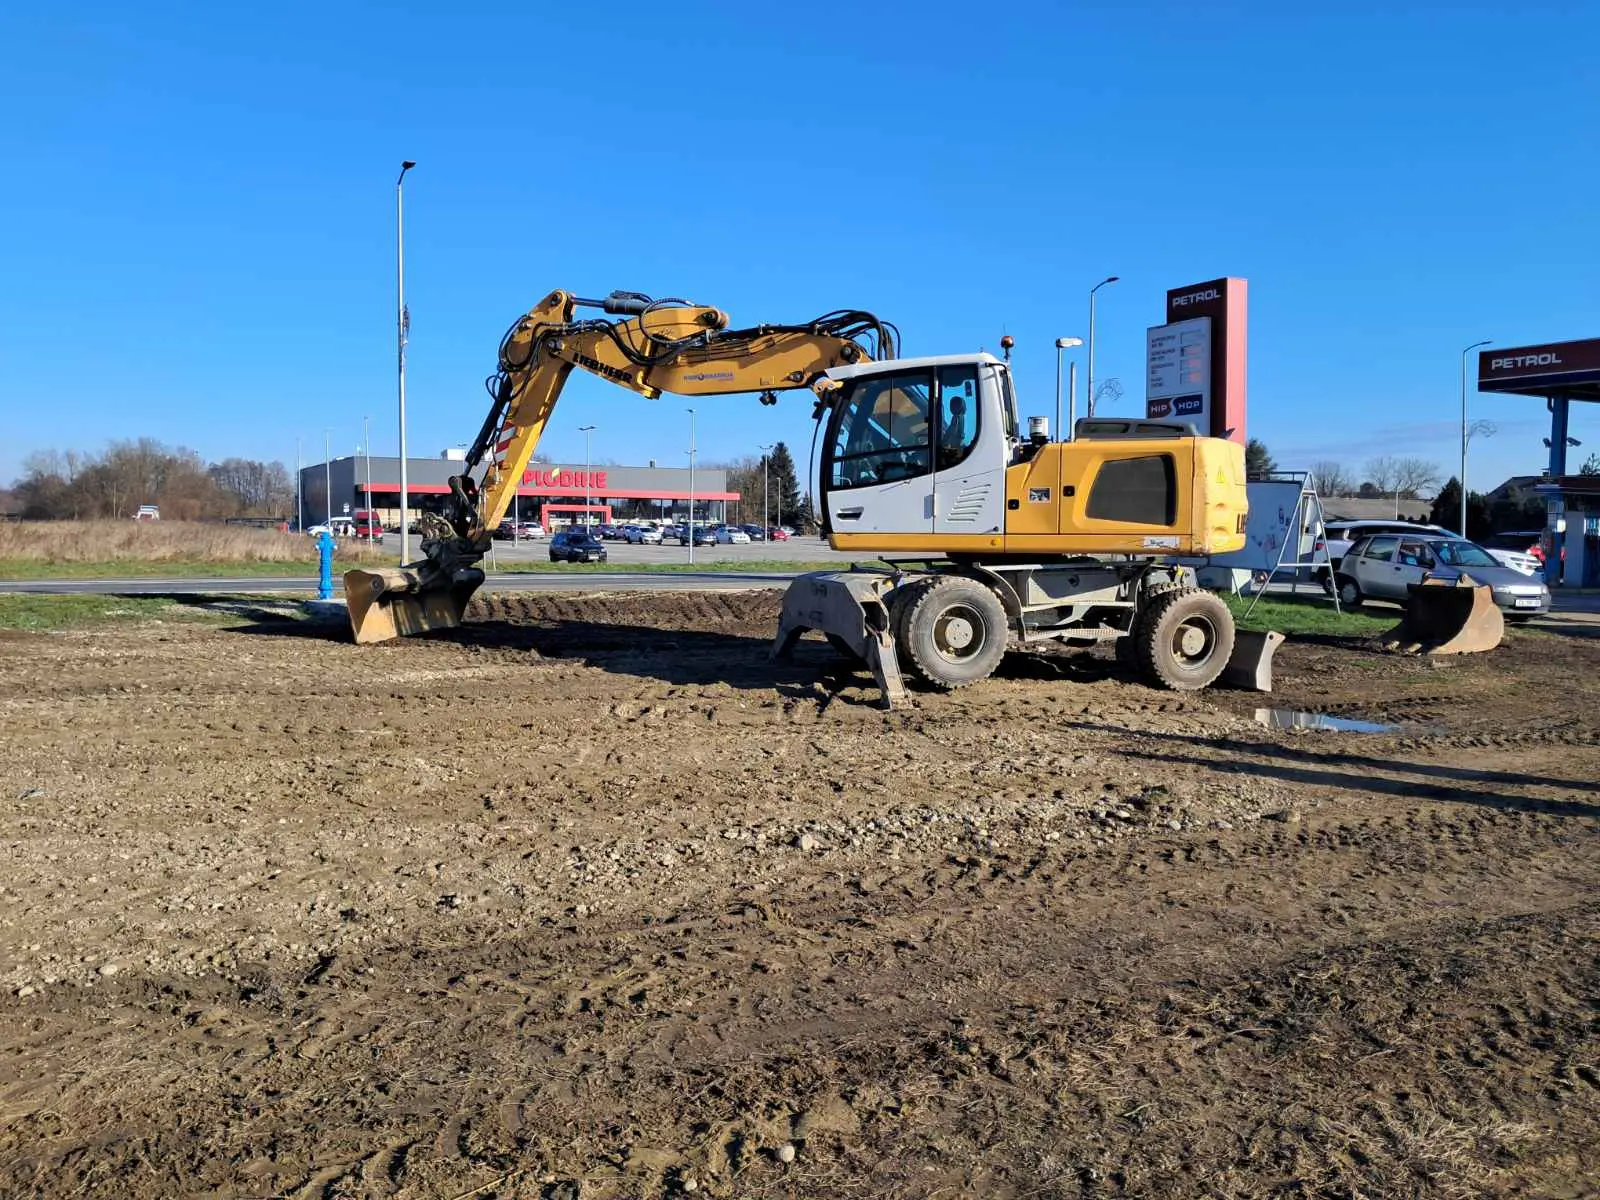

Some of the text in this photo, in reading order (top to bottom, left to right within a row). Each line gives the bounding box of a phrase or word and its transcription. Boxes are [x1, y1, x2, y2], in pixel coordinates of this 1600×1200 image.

[1172, 289, 1221, 308] PETROL
[573, 351, 633, 384] LIEBHERR
[1491, 353, 1562, 370] PETROL
[1151, 404, 1168, 414] HIP
[522, 469, 608, 488] PLODINE
